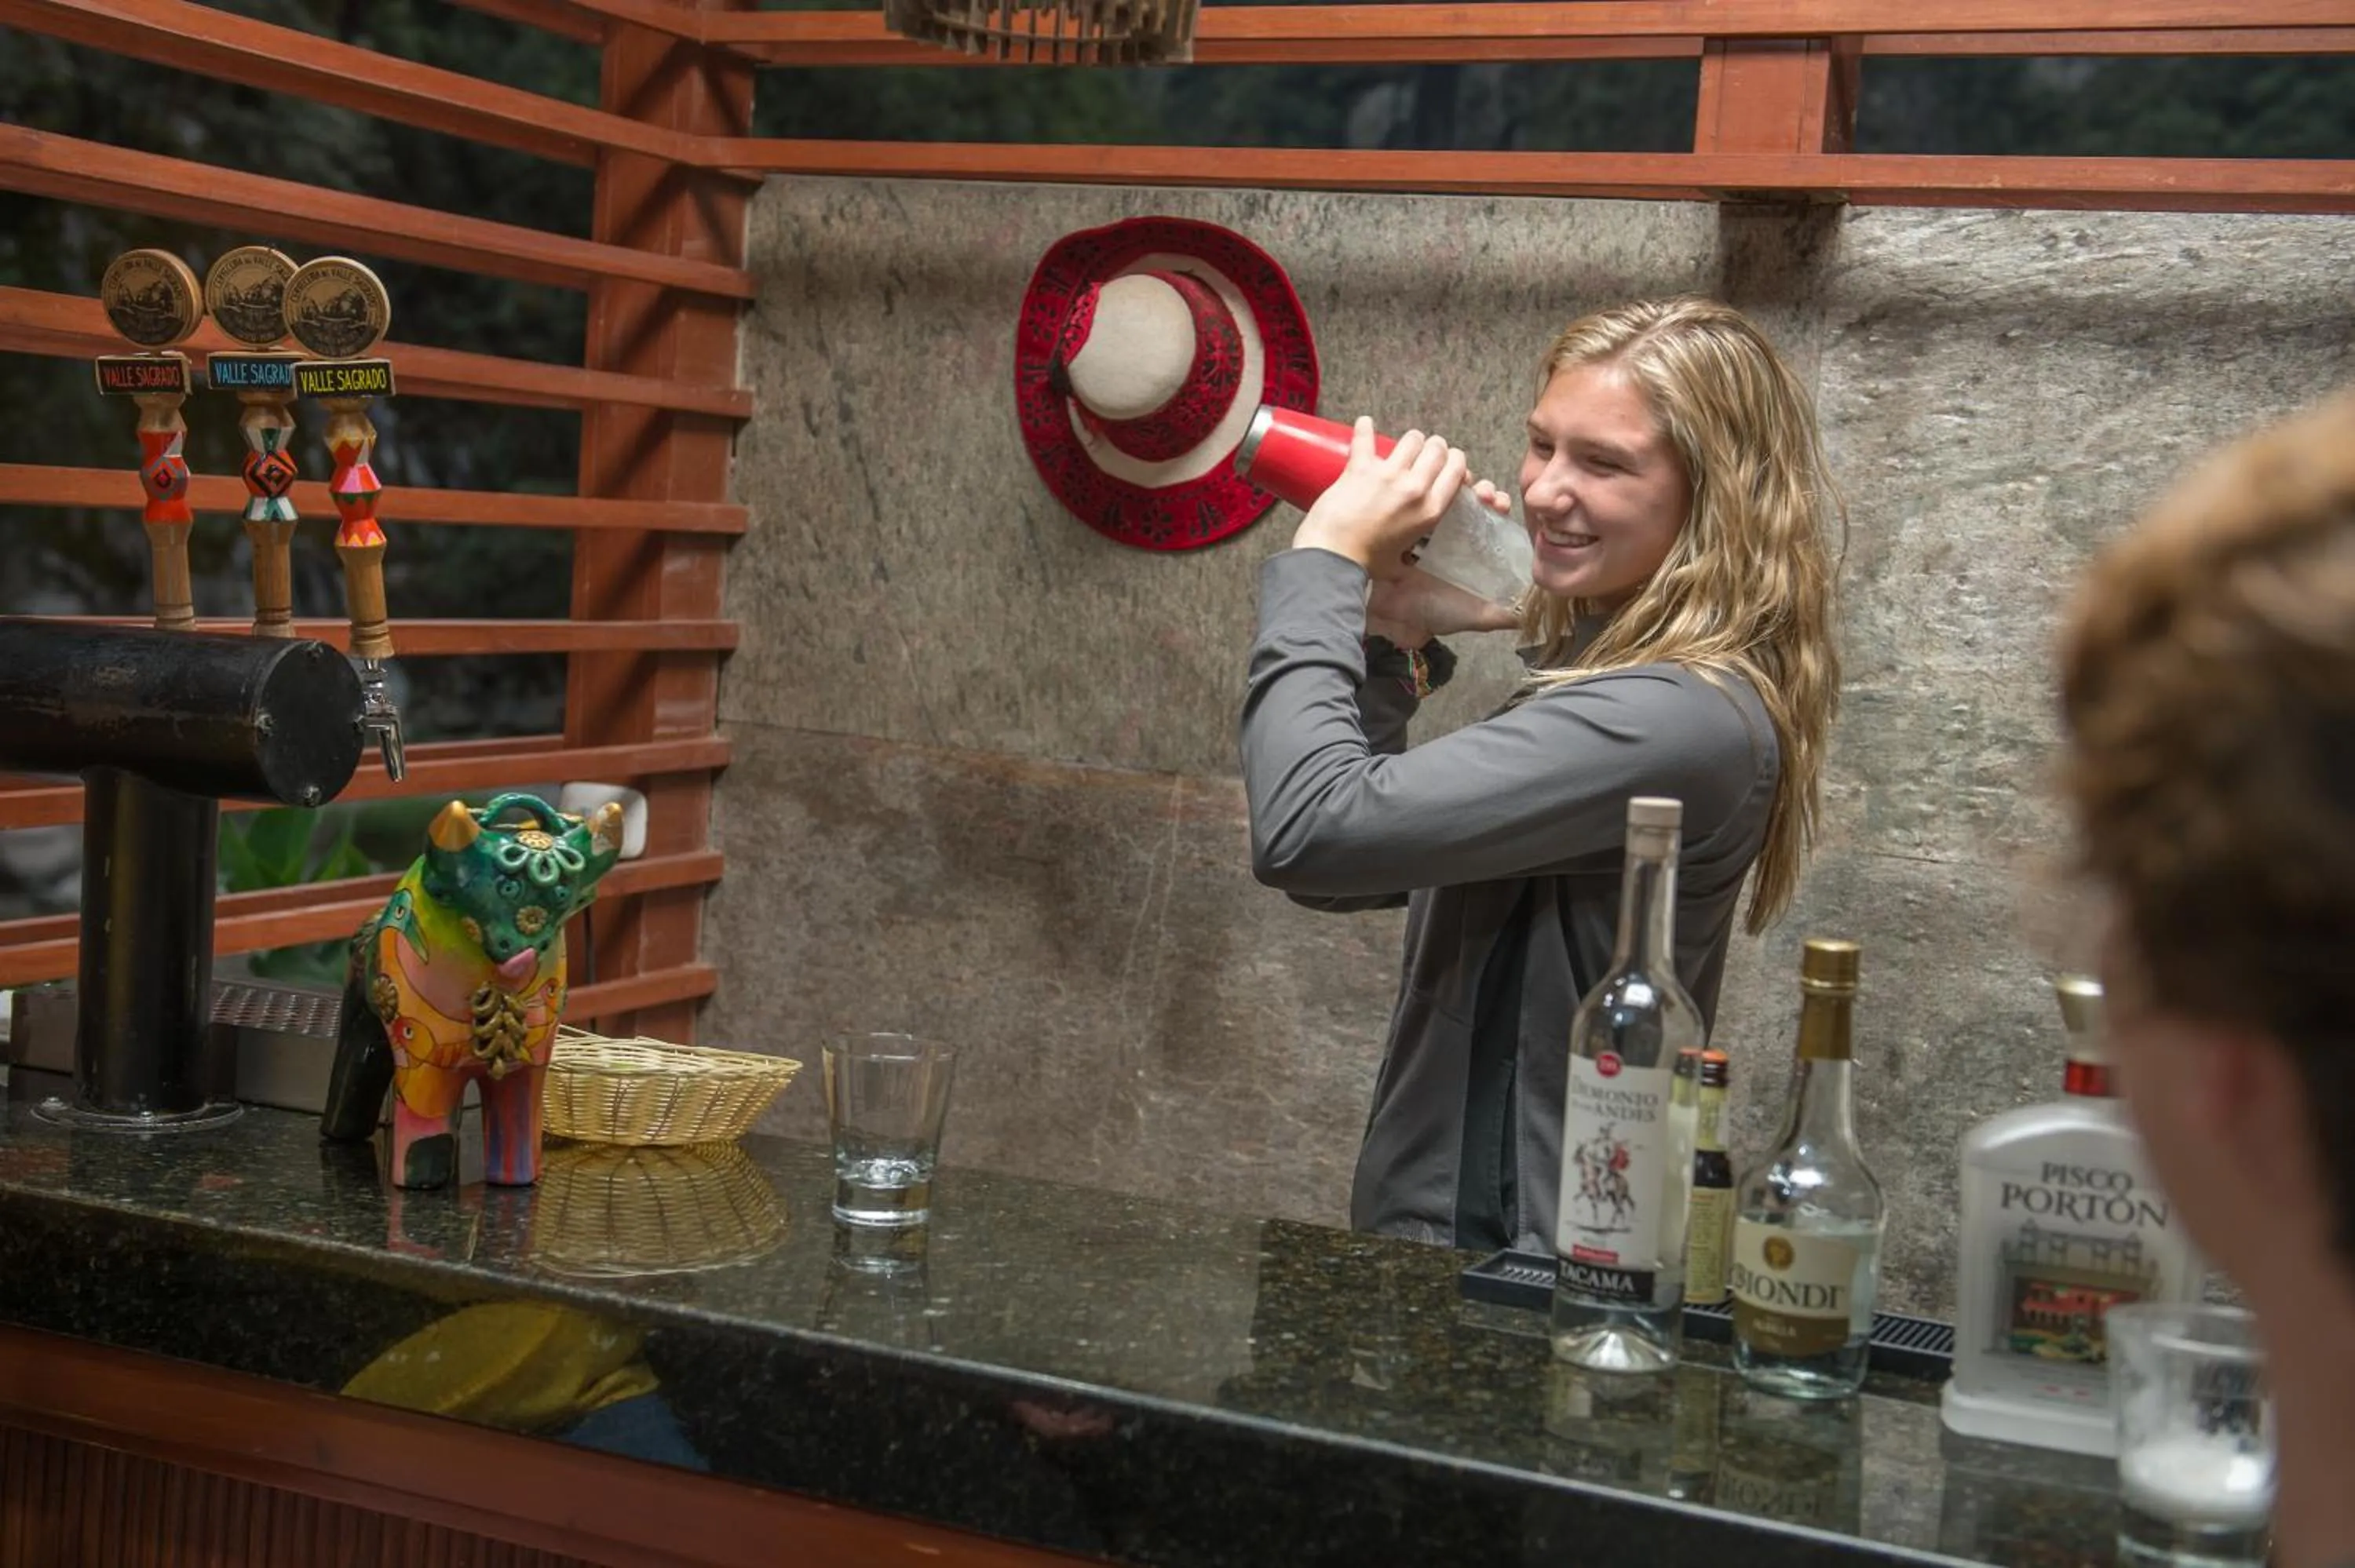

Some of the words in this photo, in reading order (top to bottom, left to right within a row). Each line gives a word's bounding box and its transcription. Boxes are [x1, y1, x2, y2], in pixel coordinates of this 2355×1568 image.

[104, 366, 134, 387] VALLE
[135, 366, 180, 387] SAGRADO
[215, 363, 248, 384] VALLE
[250, 363, 291, 385] SAGRAD
[300, 370, 335, 393] VALLE
[337, 367, 387, 391] SAGRADO
[2040, 1161, 2134, 1194] PISCO
